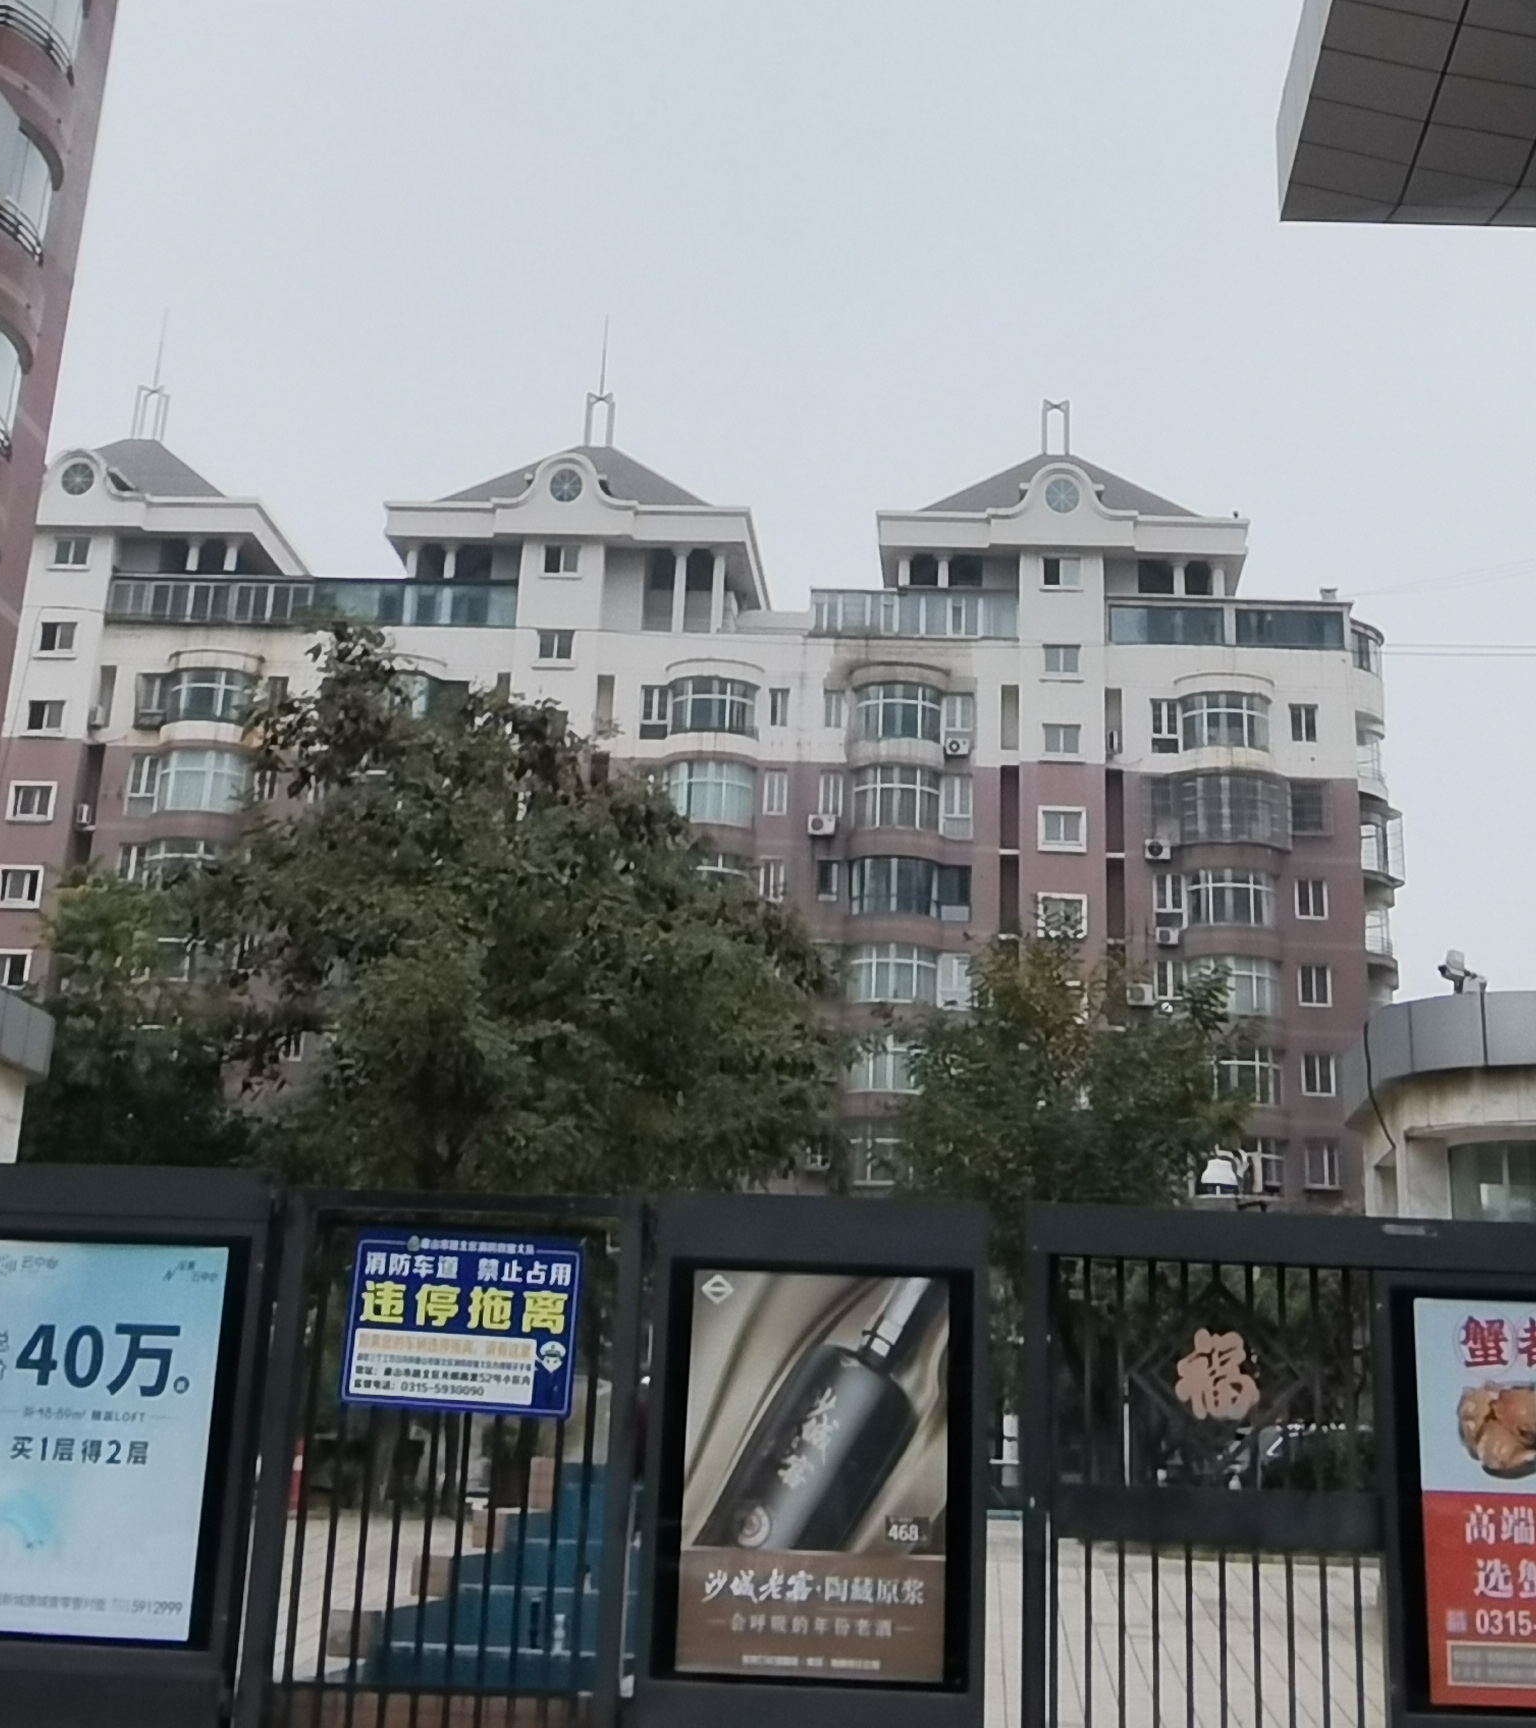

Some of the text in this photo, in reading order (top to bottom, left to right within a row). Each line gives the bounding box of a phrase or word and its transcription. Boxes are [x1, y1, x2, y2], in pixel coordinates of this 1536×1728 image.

[364, 1251, 573, 1287] 消防车道 禁止占用
[359, 1280, 570, 1336] 违停拖离
[15, 1322, 182, 1398] 40万
[10, 1435, 150, 1466] 买1层得2层
